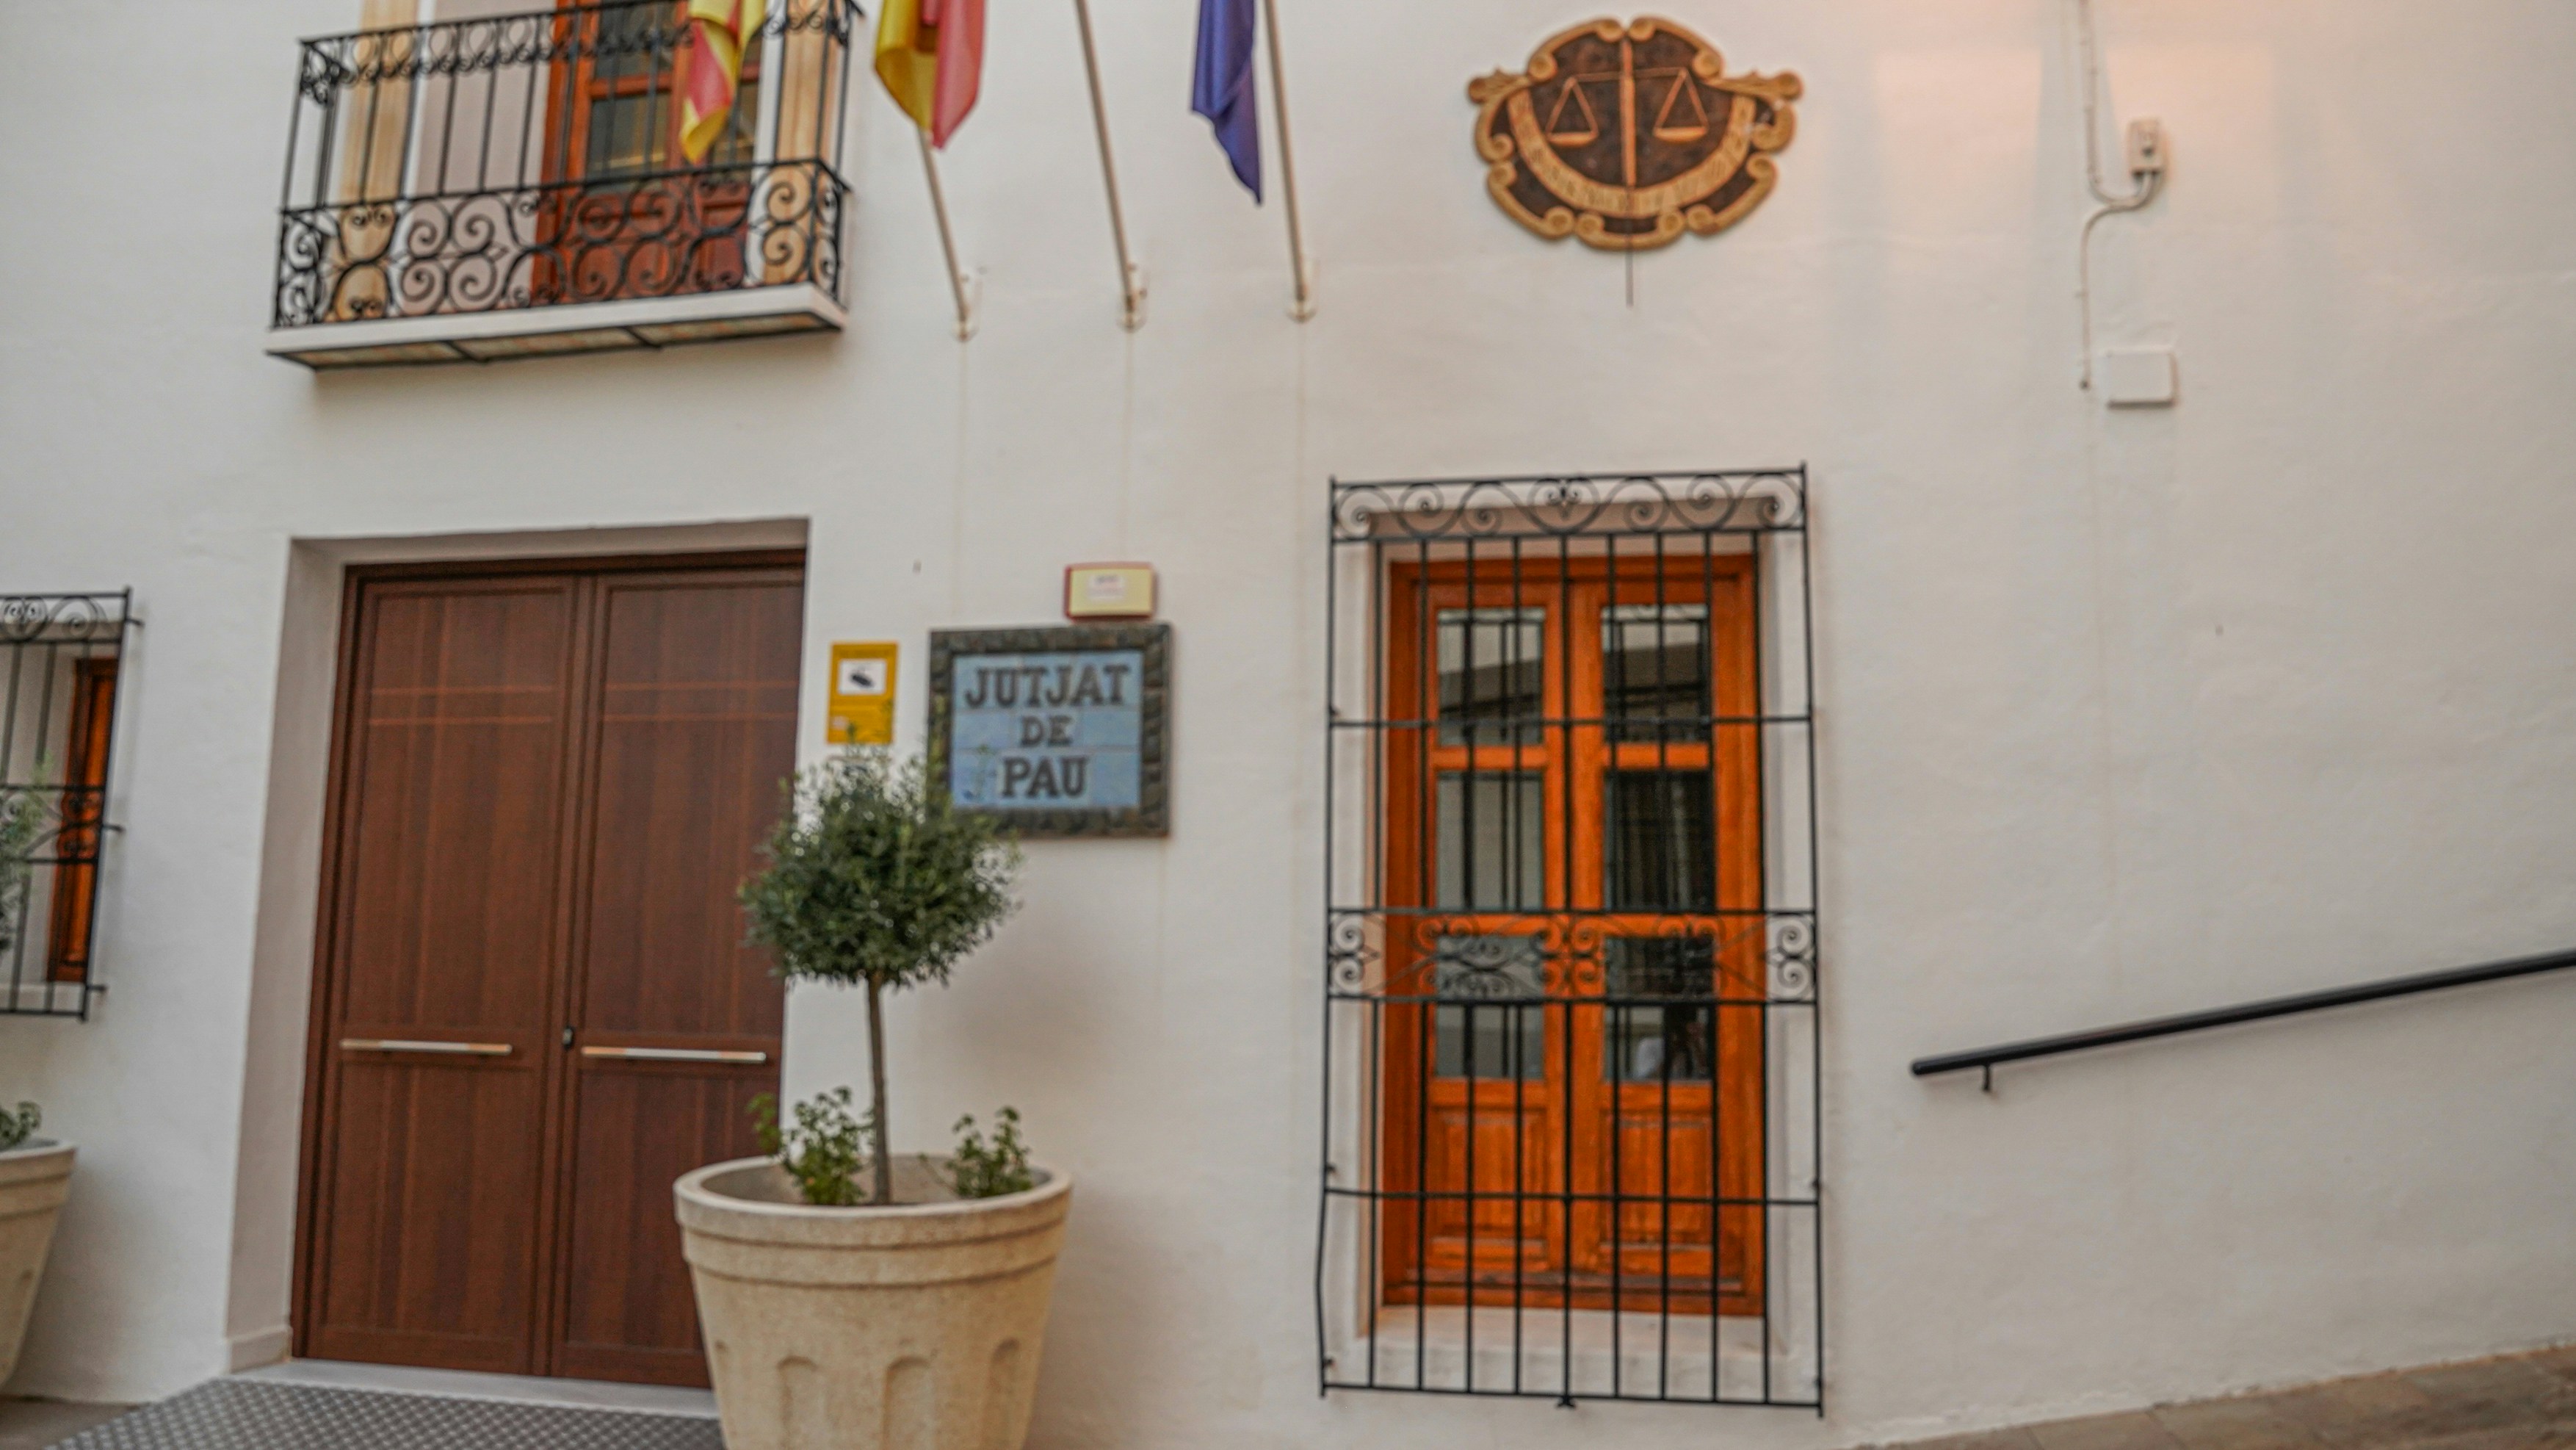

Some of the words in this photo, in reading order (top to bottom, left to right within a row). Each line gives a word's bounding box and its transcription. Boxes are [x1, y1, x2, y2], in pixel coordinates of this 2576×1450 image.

[965, 665, 1129, 707] JUTJAT
[1021, 716, 1071, 746] DE
[1002, 757, 1088, 797] PAU
